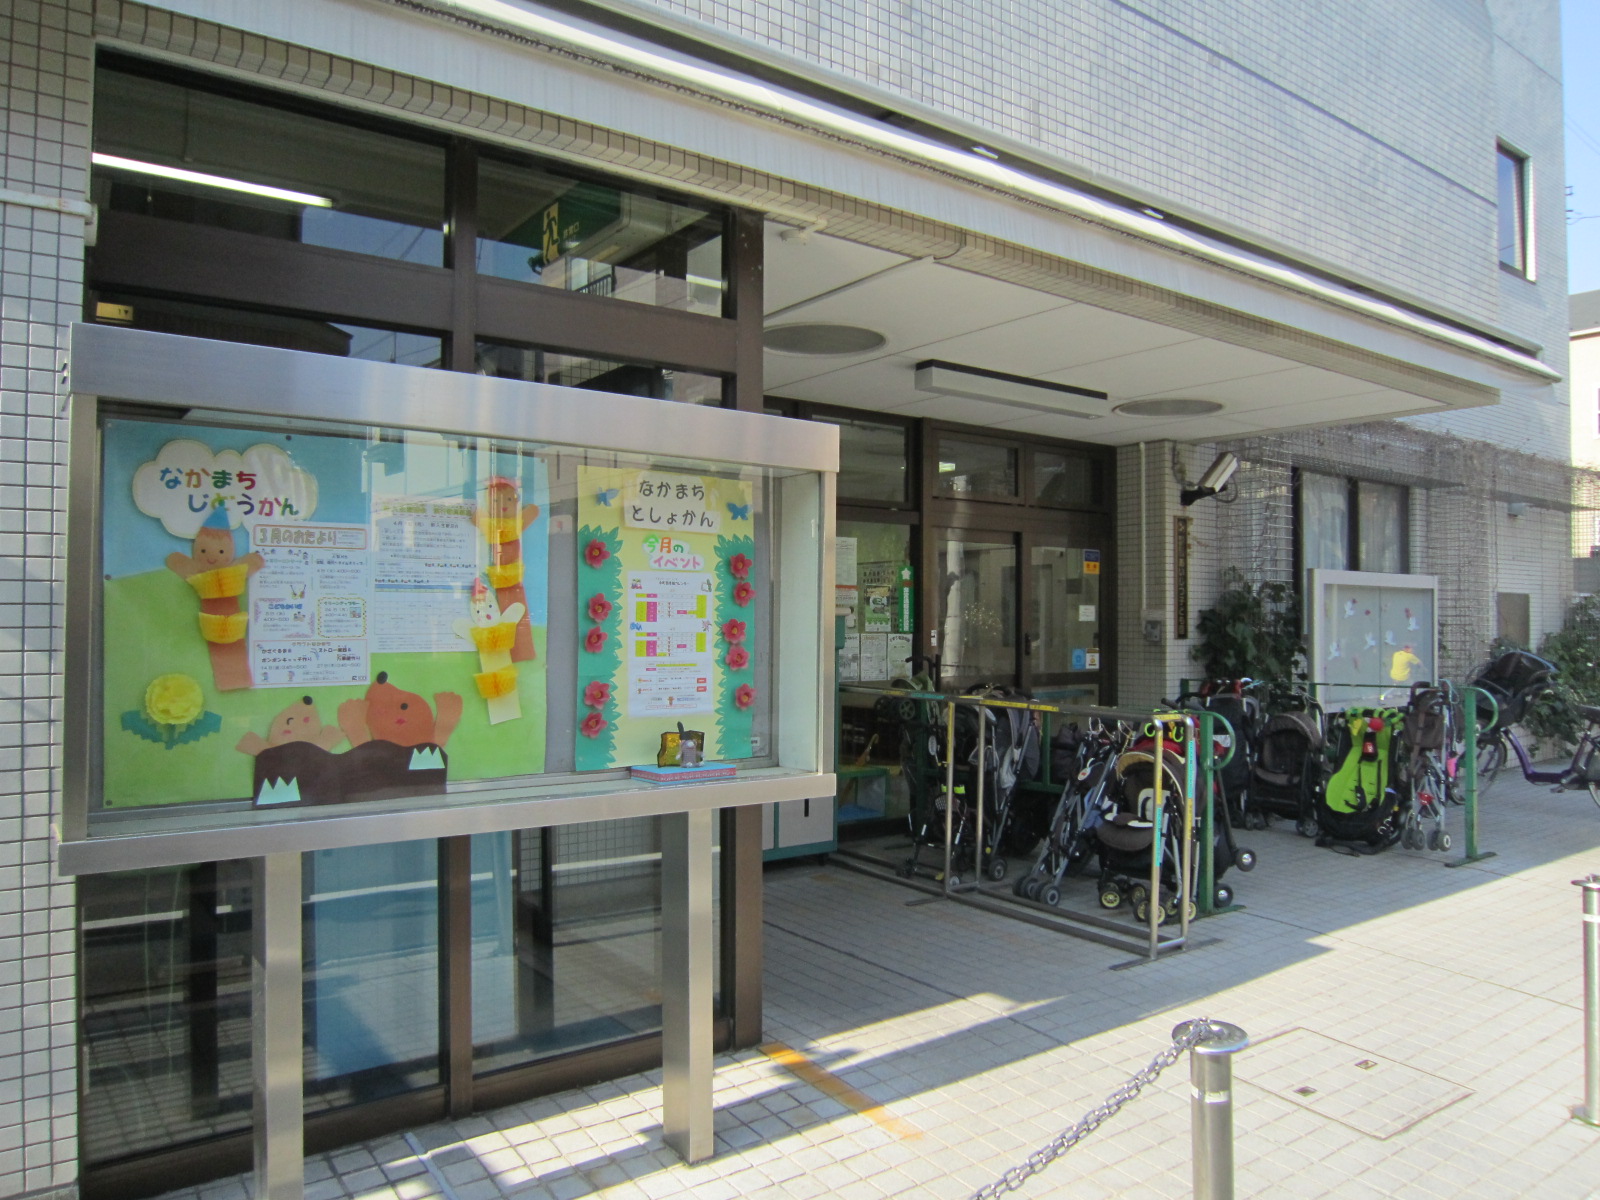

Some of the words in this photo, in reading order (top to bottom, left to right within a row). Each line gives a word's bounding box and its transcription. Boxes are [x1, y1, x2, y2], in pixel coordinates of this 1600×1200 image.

[159, 467, 257, 490] なかまち
[639, 480, 705, 501] なかまち
[632, 505, 714, 528] としょかん
[643, 533, 685, 554] 今月の
[653, 555, 701, 570] イベント
